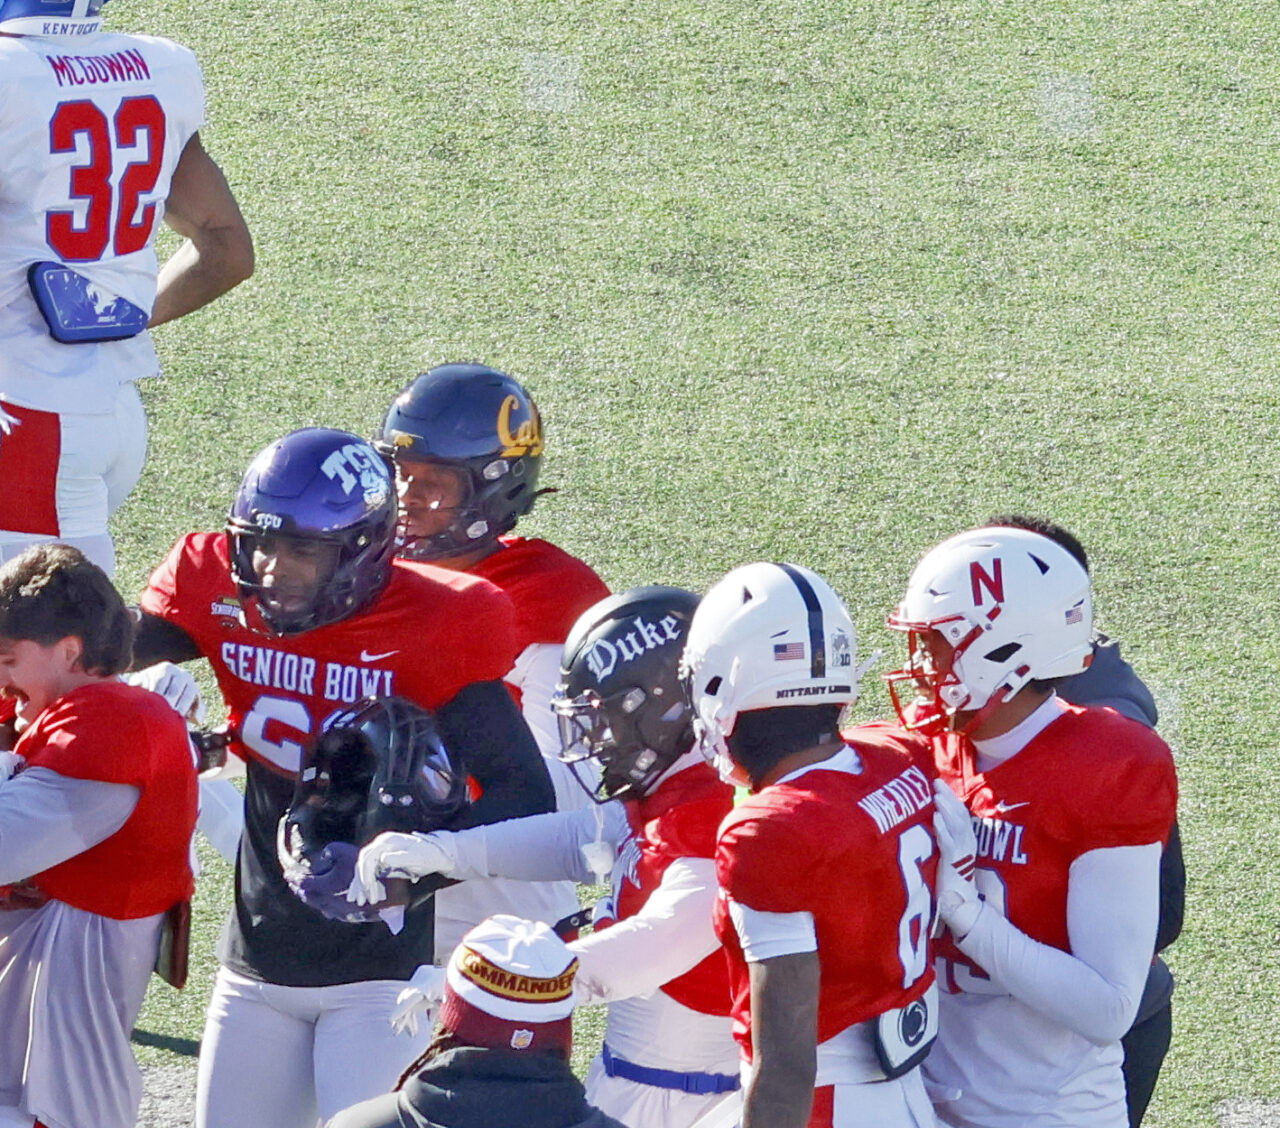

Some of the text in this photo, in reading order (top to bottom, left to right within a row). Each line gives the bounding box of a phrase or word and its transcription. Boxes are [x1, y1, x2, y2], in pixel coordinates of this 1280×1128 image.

[42, 22, 99, 35] KENTUCKY
[45, 48, 151, 87] MCGOWAN
[45, 94, 166, 262] 32
[256, 513, 283, 529] TCU
[970, 557, 1004, 607] N
[221, 642, 317, 697] SENIOR
[580, 615, 682, 684] Duke
[857, 765, 932, 834] WHEATLEY
